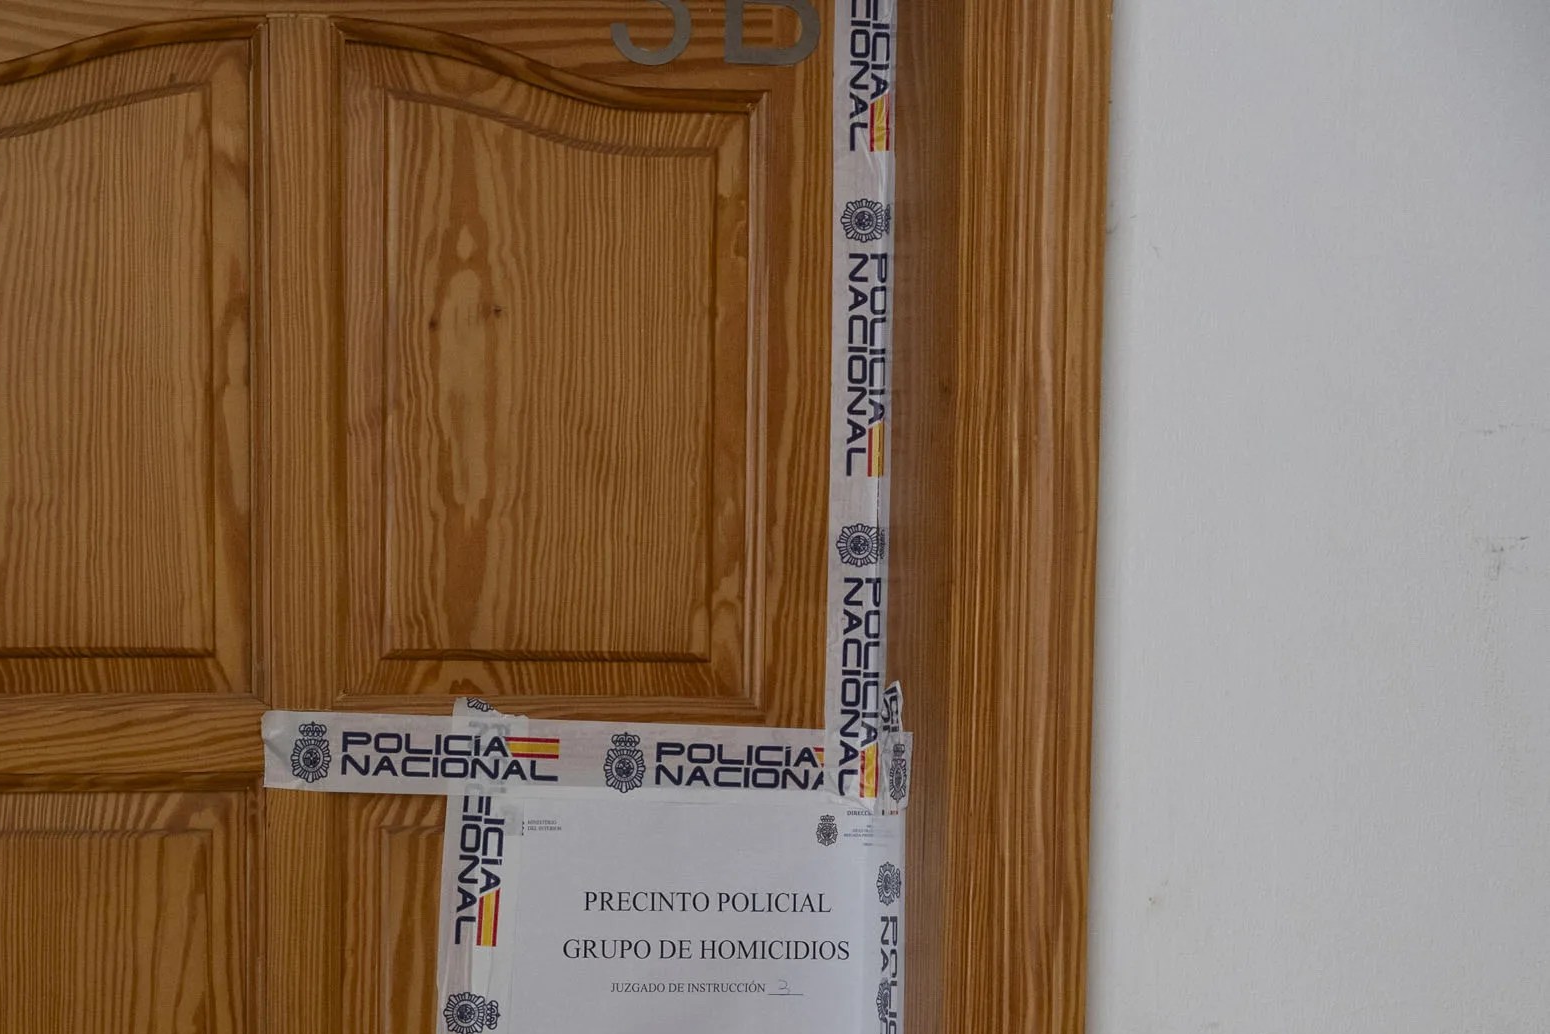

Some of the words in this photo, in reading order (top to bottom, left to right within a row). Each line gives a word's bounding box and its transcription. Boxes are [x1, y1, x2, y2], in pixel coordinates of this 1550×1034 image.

[846, 253, 869, 477] NACIONAL
[838, 577, 862, 796] NACIONAL
[341, 754, 559, 782] NACIONAL
[583, 891, 710, 913] PRECINTO
[717, 891, 832, 913] POLICIAL
[562, 938, 651, 960] GRUPO
[659, 939, 692, 960] DE
[699, 939, 850, 961] HOMICIDIOS
[610, 982, 665, 993] JUZGADO
[668, 983, 684, 993] DE
[687, 980, 766, 994] INSTRUCCIÓN
